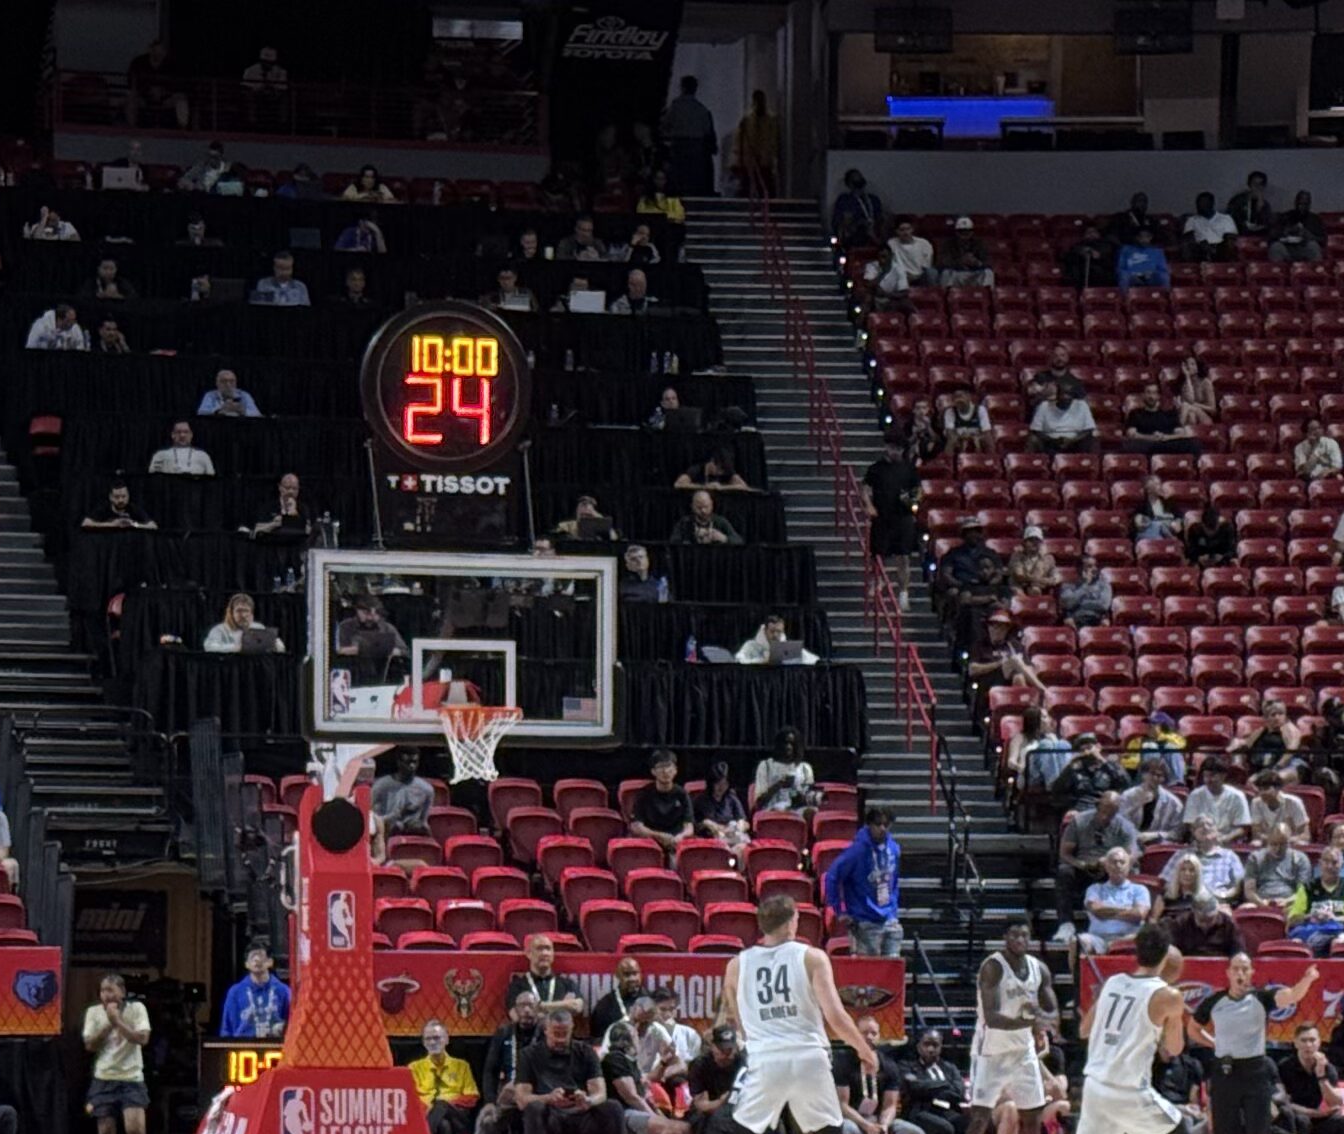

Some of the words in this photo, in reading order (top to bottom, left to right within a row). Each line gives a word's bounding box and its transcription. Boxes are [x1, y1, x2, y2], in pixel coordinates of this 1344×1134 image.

[560, 48, 654, 60] TOYOTA
[411, 335, 498, 376] 10:00
[403, 375, 491, 445] 24
[420, 475, 511, 495] TISSOT
[756, 964, 792, 1005] 34
[1104, 992, 1137, 1031] 77
[319, 1088, 408, 1125] SUMMER
